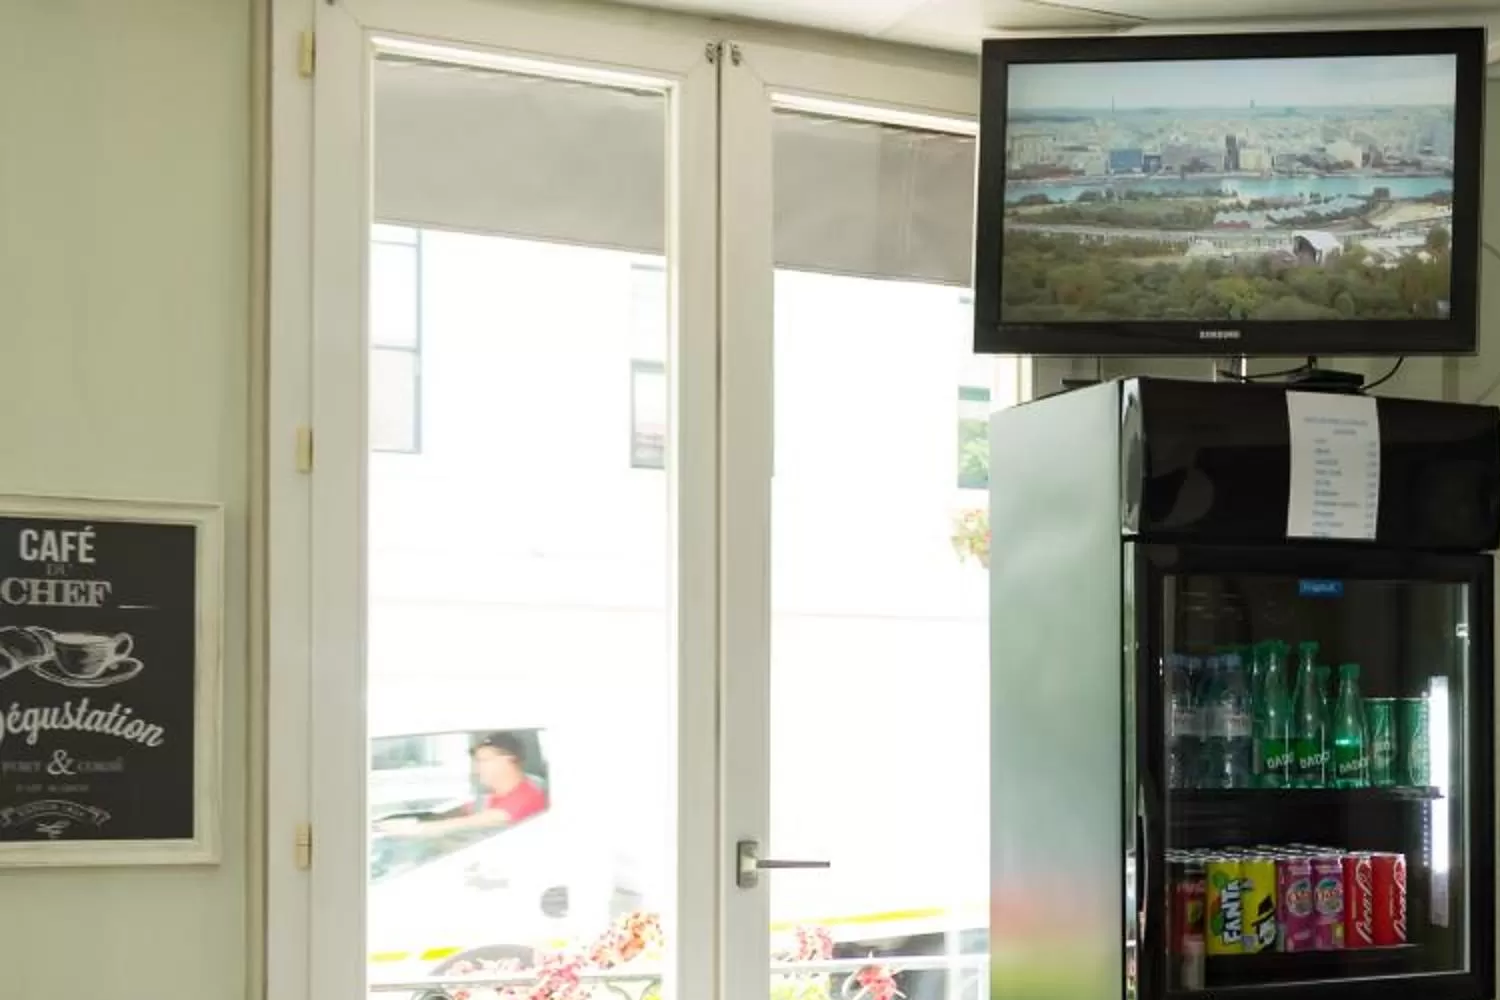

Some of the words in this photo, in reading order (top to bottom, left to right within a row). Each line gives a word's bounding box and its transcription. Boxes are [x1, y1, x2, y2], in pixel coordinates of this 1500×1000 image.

[19, 525, 96, 563] CAFÉ
[1, 576, 112, 608] CHEF
[0, 697, 164, 747] égustation
[47, 748, 76, 775] &
